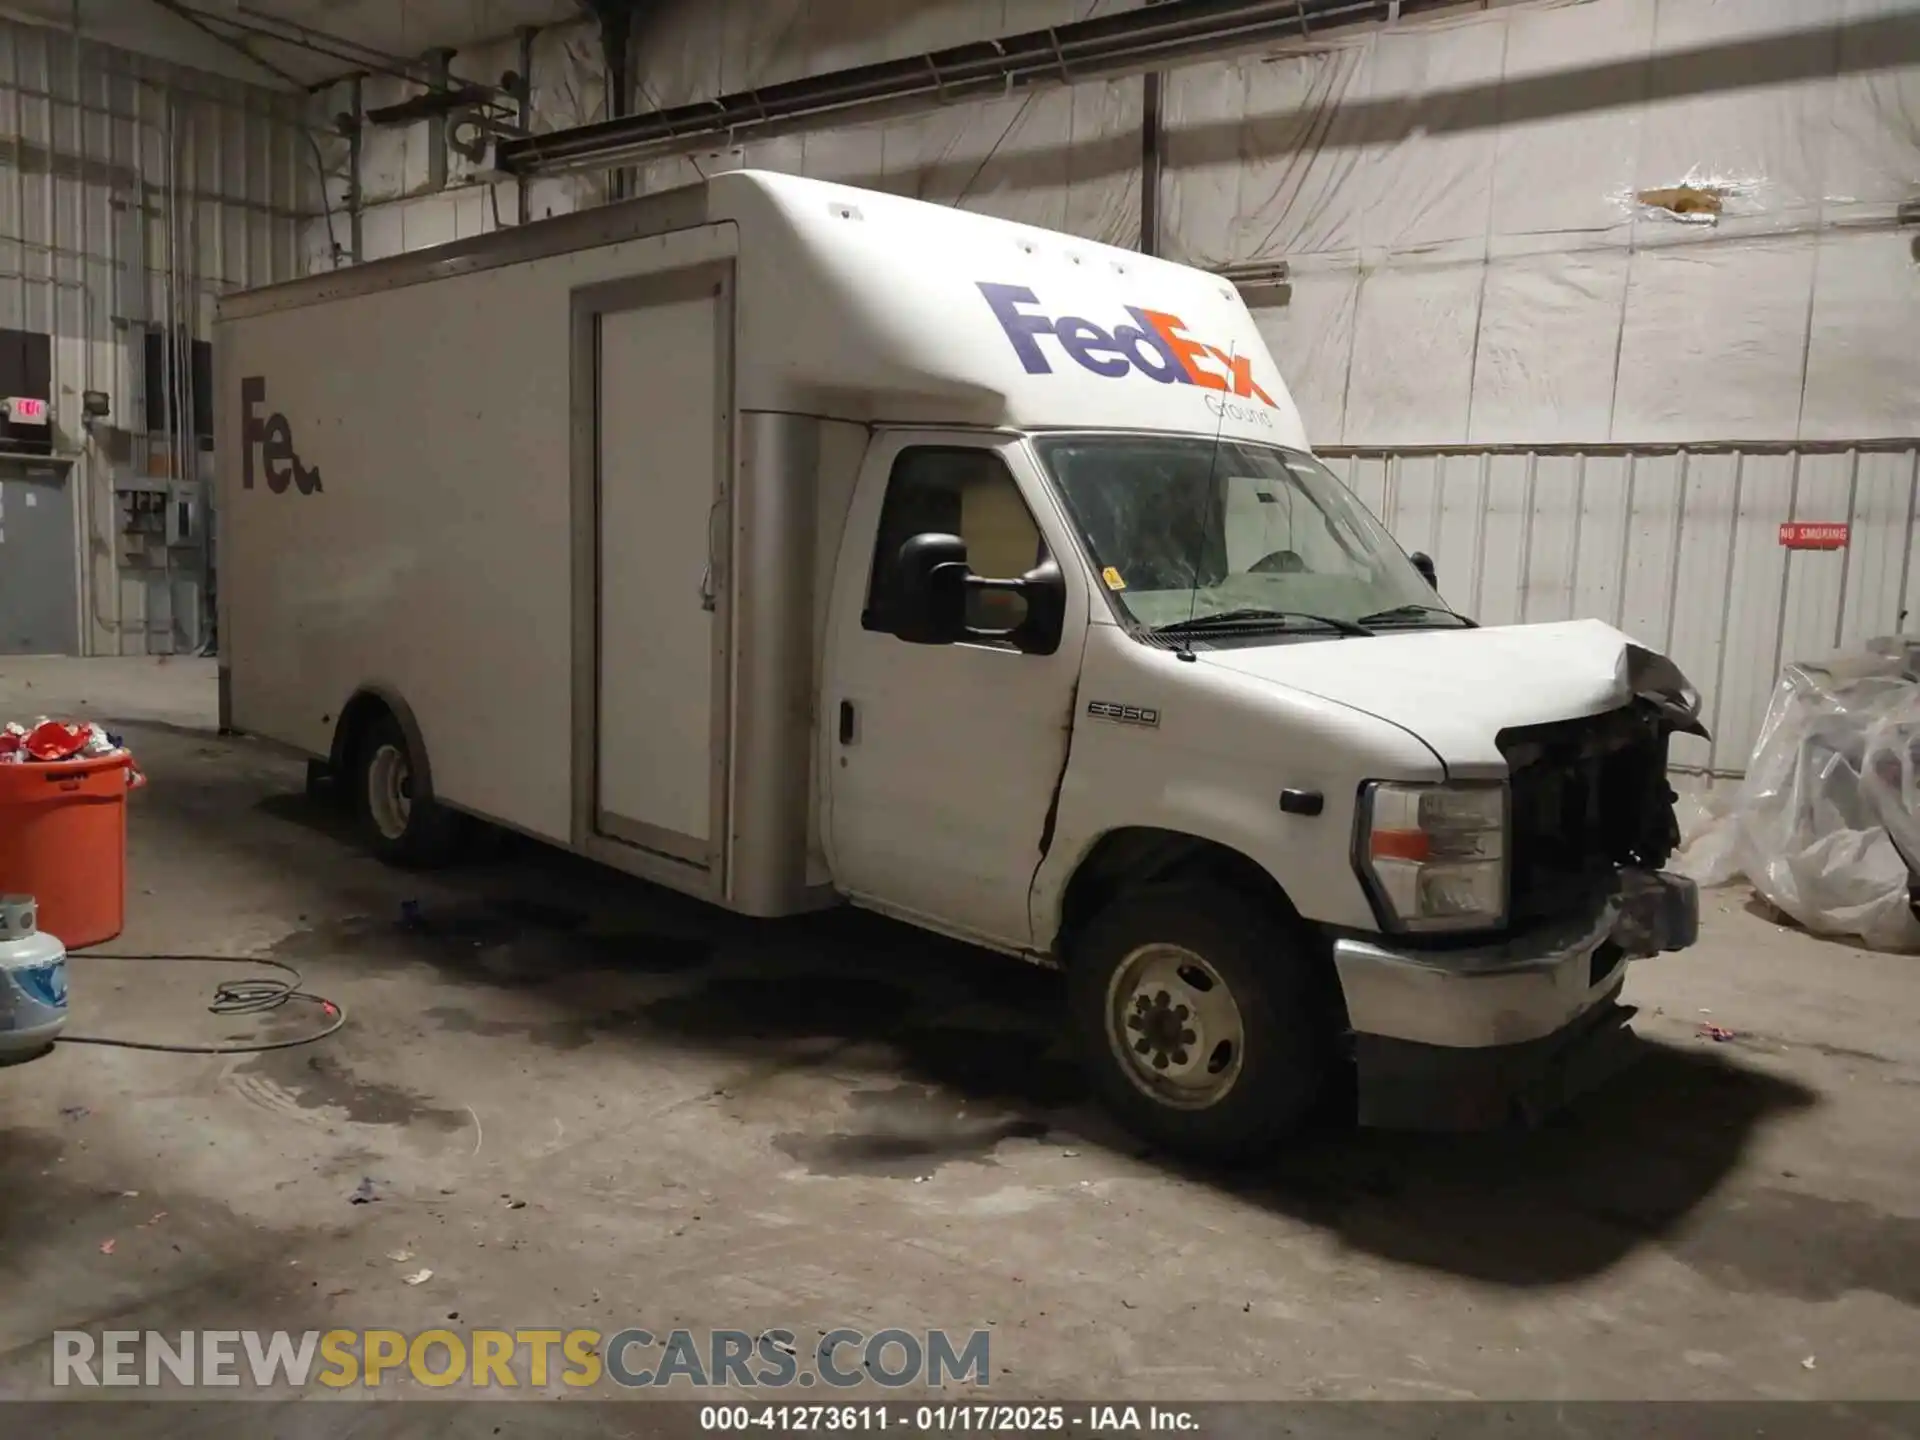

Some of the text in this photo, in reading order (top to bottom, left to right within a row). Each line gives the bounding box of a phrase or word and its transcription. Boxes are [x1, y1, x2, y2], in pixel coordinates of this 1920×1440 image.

[976, 282, 1280, 410] FedEx
[1780, 527, 1847, 540] NO SMOKING
